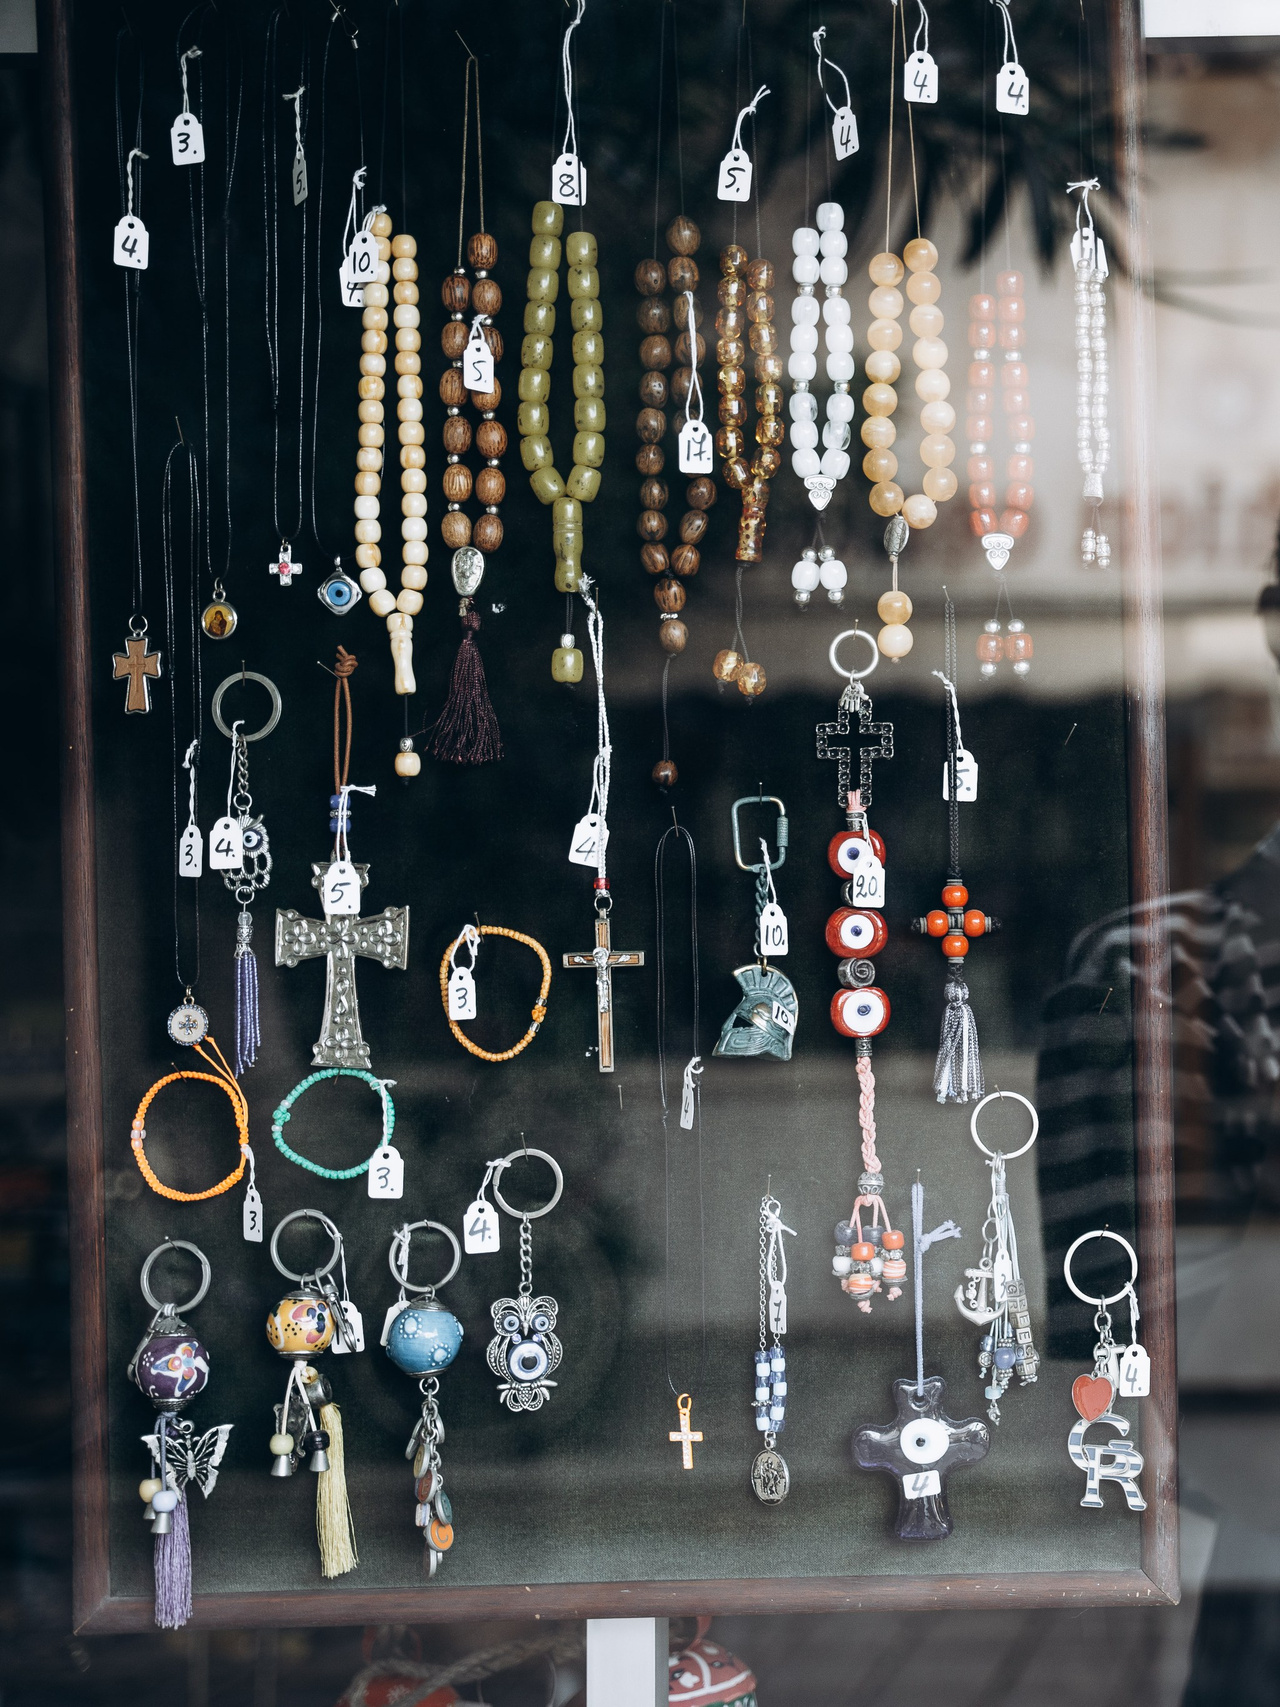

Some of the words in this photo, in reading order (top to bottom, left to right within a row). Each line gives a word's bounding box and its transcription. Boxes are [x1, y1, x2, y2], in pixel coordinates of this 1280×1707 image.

[912, 69, 931, 99] 4.
[1007, 81, 1026, 108] 4.
[177, 132, 197, 155] 3.
[840, 124, 856, 153] 4.
[296, 170, 306, 195] 5.
[559, 173, 579, 198] 8.
[724, 167, 746, 193] 5.
[121, 235, 142, 264] 4.
[352, 251, 374, 275] 10.
[472, 360, 488, 383] 5.
[686, 432, 711, 462] 17.
[185, 844, 198, 868] 3.
[214, 838, 236, 858] 4.
[330, 882, 352, 909] 5.
[765, 924, 786, 947] 10.
[455, 987, 472, 1013] 3.
[376, 1166, 395, 1192] 3.
[249, 1210, 261, 1234] 3.
[468, 1216, 493, 1243] 4.
[1125, 1363, 1143, 1394] 4.
[911, 1473, 930, 1498] 4
